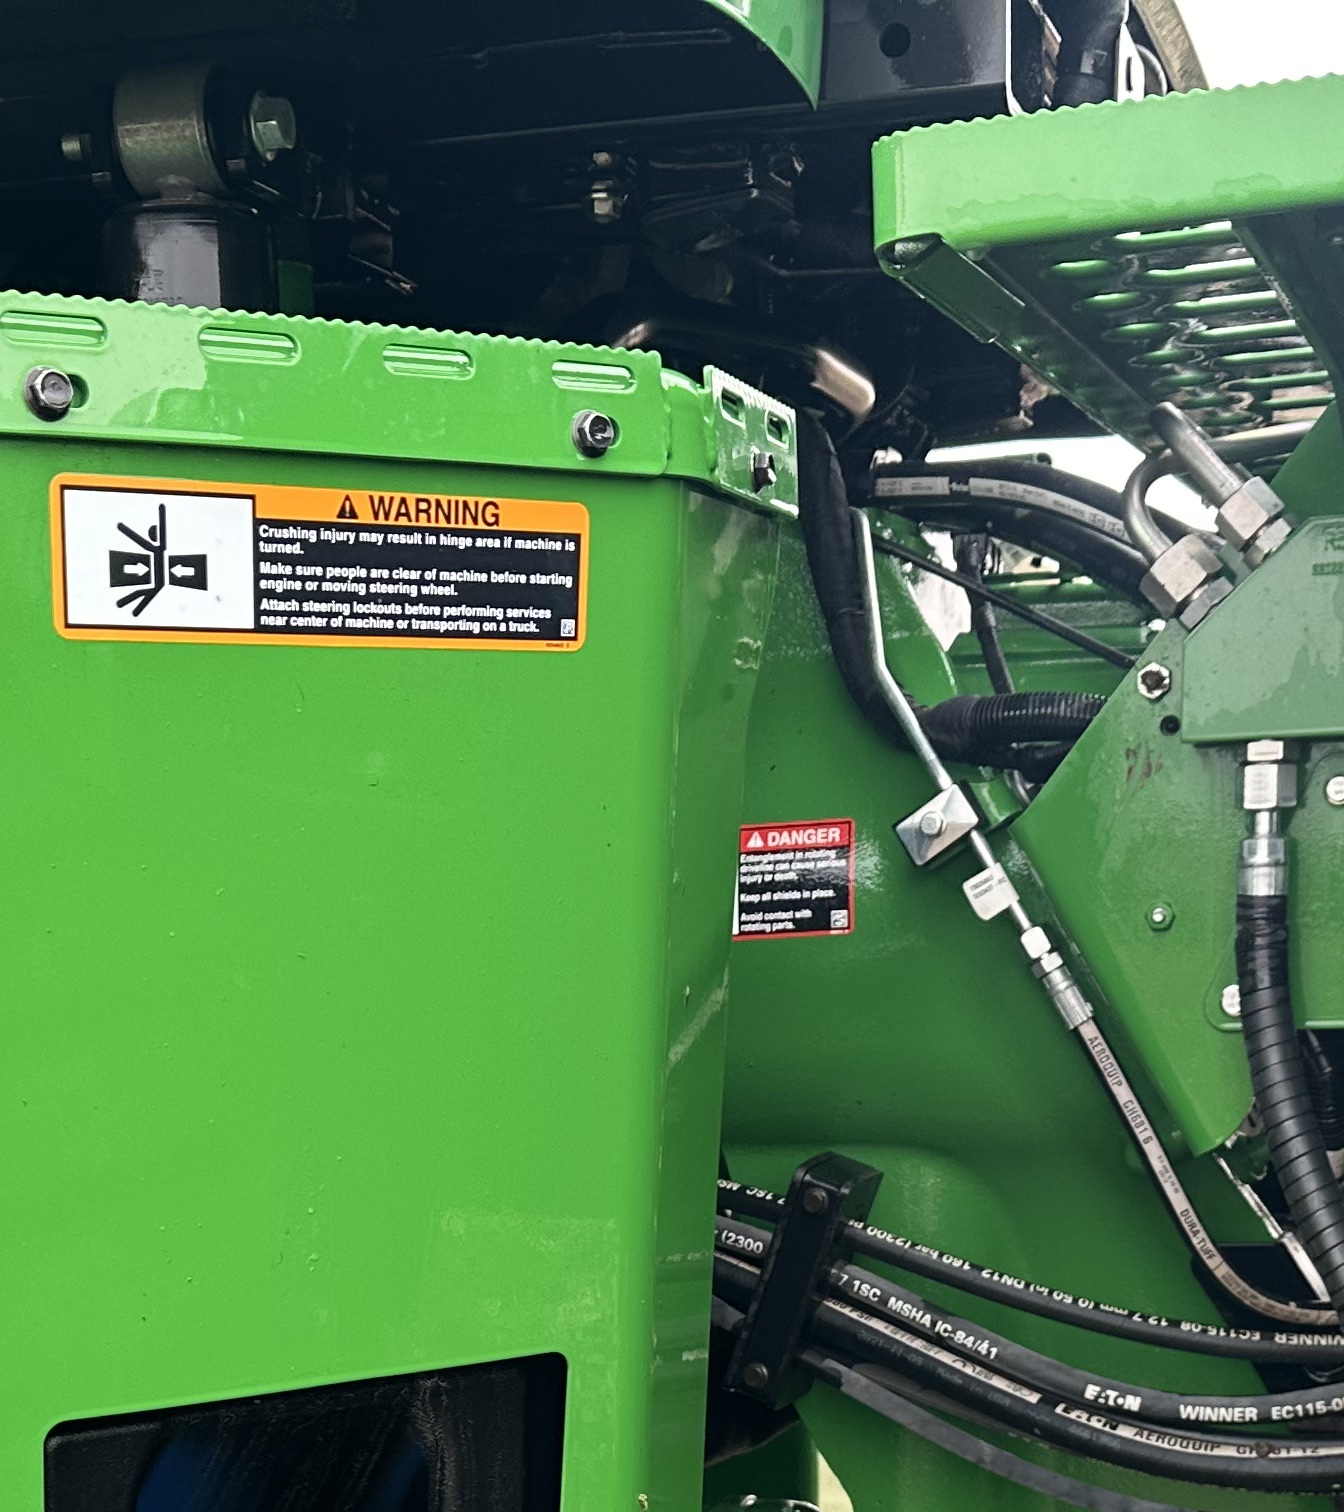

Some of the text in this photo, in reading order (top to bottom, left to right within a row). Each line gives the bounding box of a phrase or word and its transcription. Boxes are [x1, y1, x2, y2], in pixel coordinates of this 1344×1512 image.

[369, 494, 501, 527] WARNING
[258, 524, 576, 551] Crushing injury may result in hinge area if machine is
[258, 540, 304, 554] turned.
[259, 561, 573, 588] Make sure people are clear of machine before starting
[259, 578, 458, 597] engine or moving steering wheel.
[260, 597, 552, 620] Attach steering lockouts before performing services
[260, 615, 540, 634] near center of machine or transporting on a truck.
[767, 828, 841, 846] DANGER
[1088, 1036, 1123, 1088] AEROQUIP
[1180, 1208, 1217, 1260] DURA-TUFF
[721, 1230, 764, 1254] (2300
[942, 1253, 971, 1271] 160
[981, 1268, 1026, 1290] DN12
[852, 1279, 883, 1303] 1SC
[886, 1296, 931, 1328] MSHA
[934, 1320, 999, 1361] IC-84/41
[1179, 1403, 1258, 1423] WINNER
